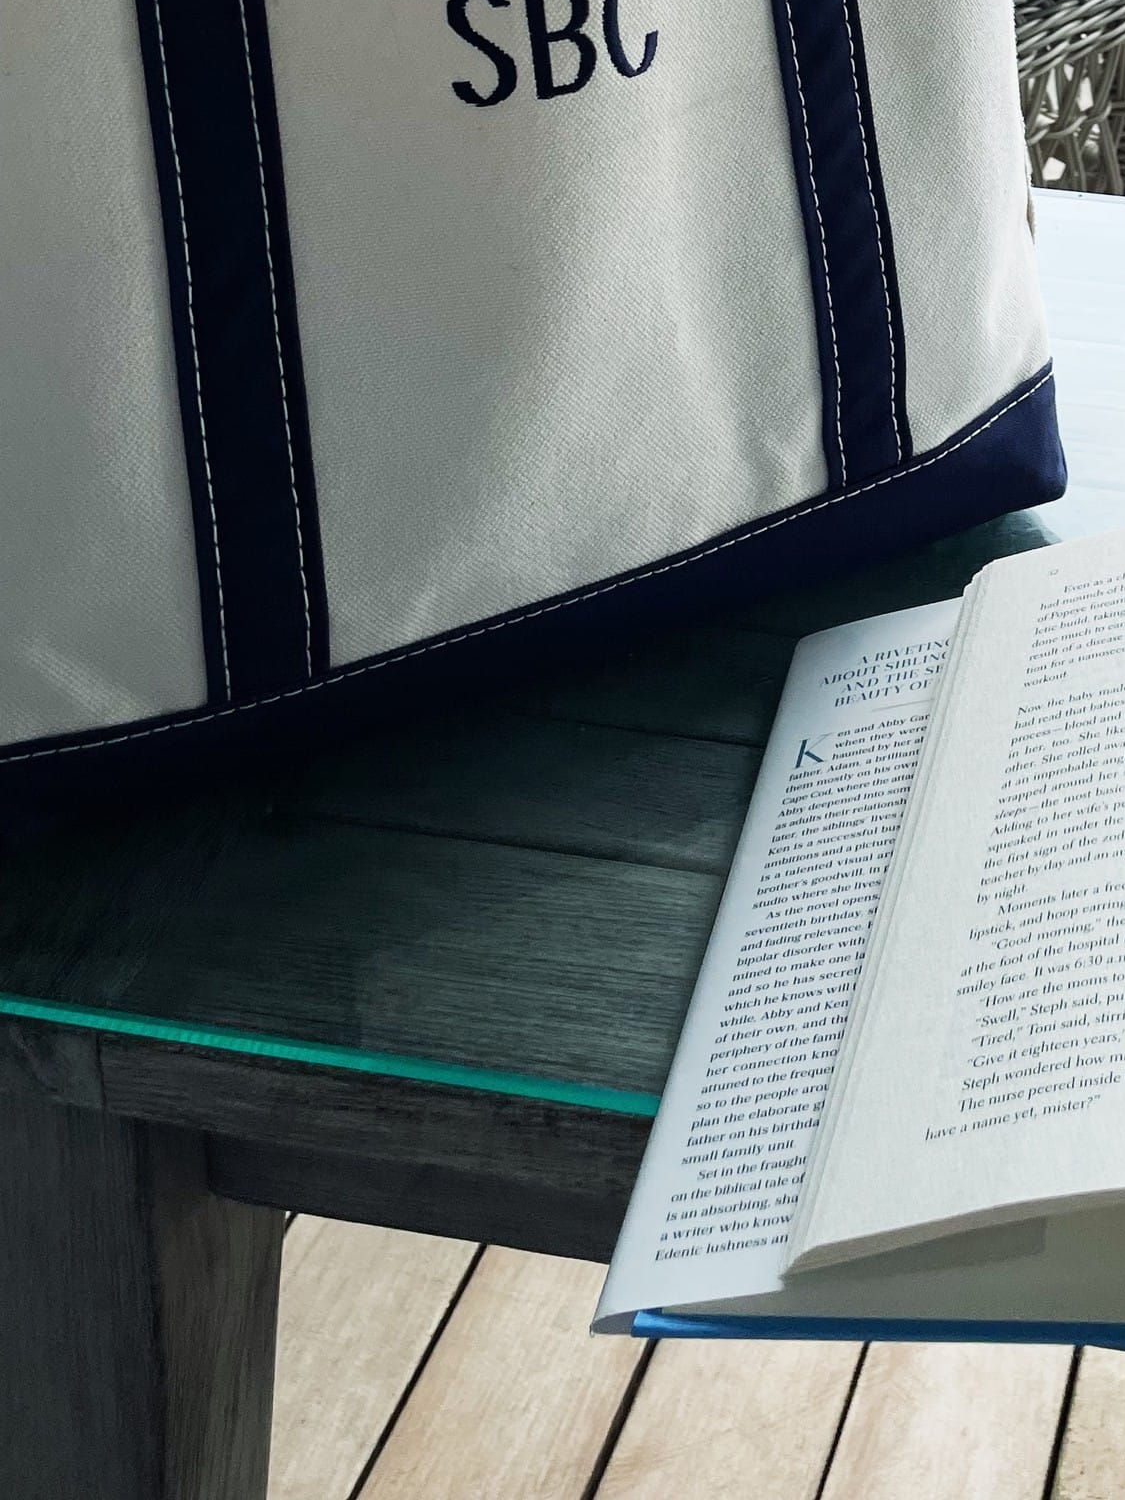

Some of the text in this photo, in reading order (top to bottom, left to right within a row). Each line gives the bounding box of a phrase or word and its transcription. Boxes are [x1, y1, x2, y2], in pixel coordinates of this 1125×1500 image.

[860, 656, 868, 665] A
[820, 664, 880, 688] ABOUT
[841, 670, 919, 693] AND THE
[834, 679, 933, 707] BEAUTY OF
[1018, 704, 1042, 714] Now
[1047, 698, 1065, 707] the
[1068, 691, 1093, 702] baby
[1014, 716, 1035, 729] had
[1038, 709, 1062, 723] read
[1065, 705, 1087, 716] that
[1089, 699, 1125, 712] babies
[835, 725, 927, 748] when they were
[785, 782, 813, 793] them
[816, 773, 854, 785] mostly
[874, 766, 891, 774] his
[893, 760, 918, 770] own
[778, 791, 885, 817] Abby deepened into
[764, 838, 896, 868] ambitions and picture
[784, 907, 804, 915] the
[806, 898, 839, 911] novel
[736, 938, 865, 966] bipolar disorder with
[728, 975, 815, 996] and so he has
[955, 979, 996, 995] smiley
[1033, 966, 1043, 977] It
[1046, 964, 1070, 973] was
[1017, 988, 1039, 999] are
[1041, 981, 1063, 994] the
[1066, 976, 1108, 989] moms
[724, 982, 850, 1011] which he knows will
[1029, 998, 1068, 1015] Steph
[1028, 1020, 1056, 1035] Toni
[1020, 1039, 1079, 1057] eighteen
[960, 1071, 1000, 1090] Steph
[1004, 1056, 1072, 1080] wondered
[1074, 1054, 1104, 1067] how
[957, 1097, 985, 1111] The
[987, 1090, 1025, 1105] nurse
[1026, 1076, 1076, 1100] peered
[1078, 1071, 1121, 1087] inside
[691, 1103, 810, 1131] plan the elaborate
[924, 1126, 956, 1140] have
[971, 1114, 1010, 1130] name
[682, 1144, 763, 1163] small family
[699, 1155, 807, 1179] Set in the fraught
[671, 1176, 789, 1202] on the biblical tale
[673, 1220, 749, 1238] writer who
[655, 1238, 767, 1260] Edenic lushness
